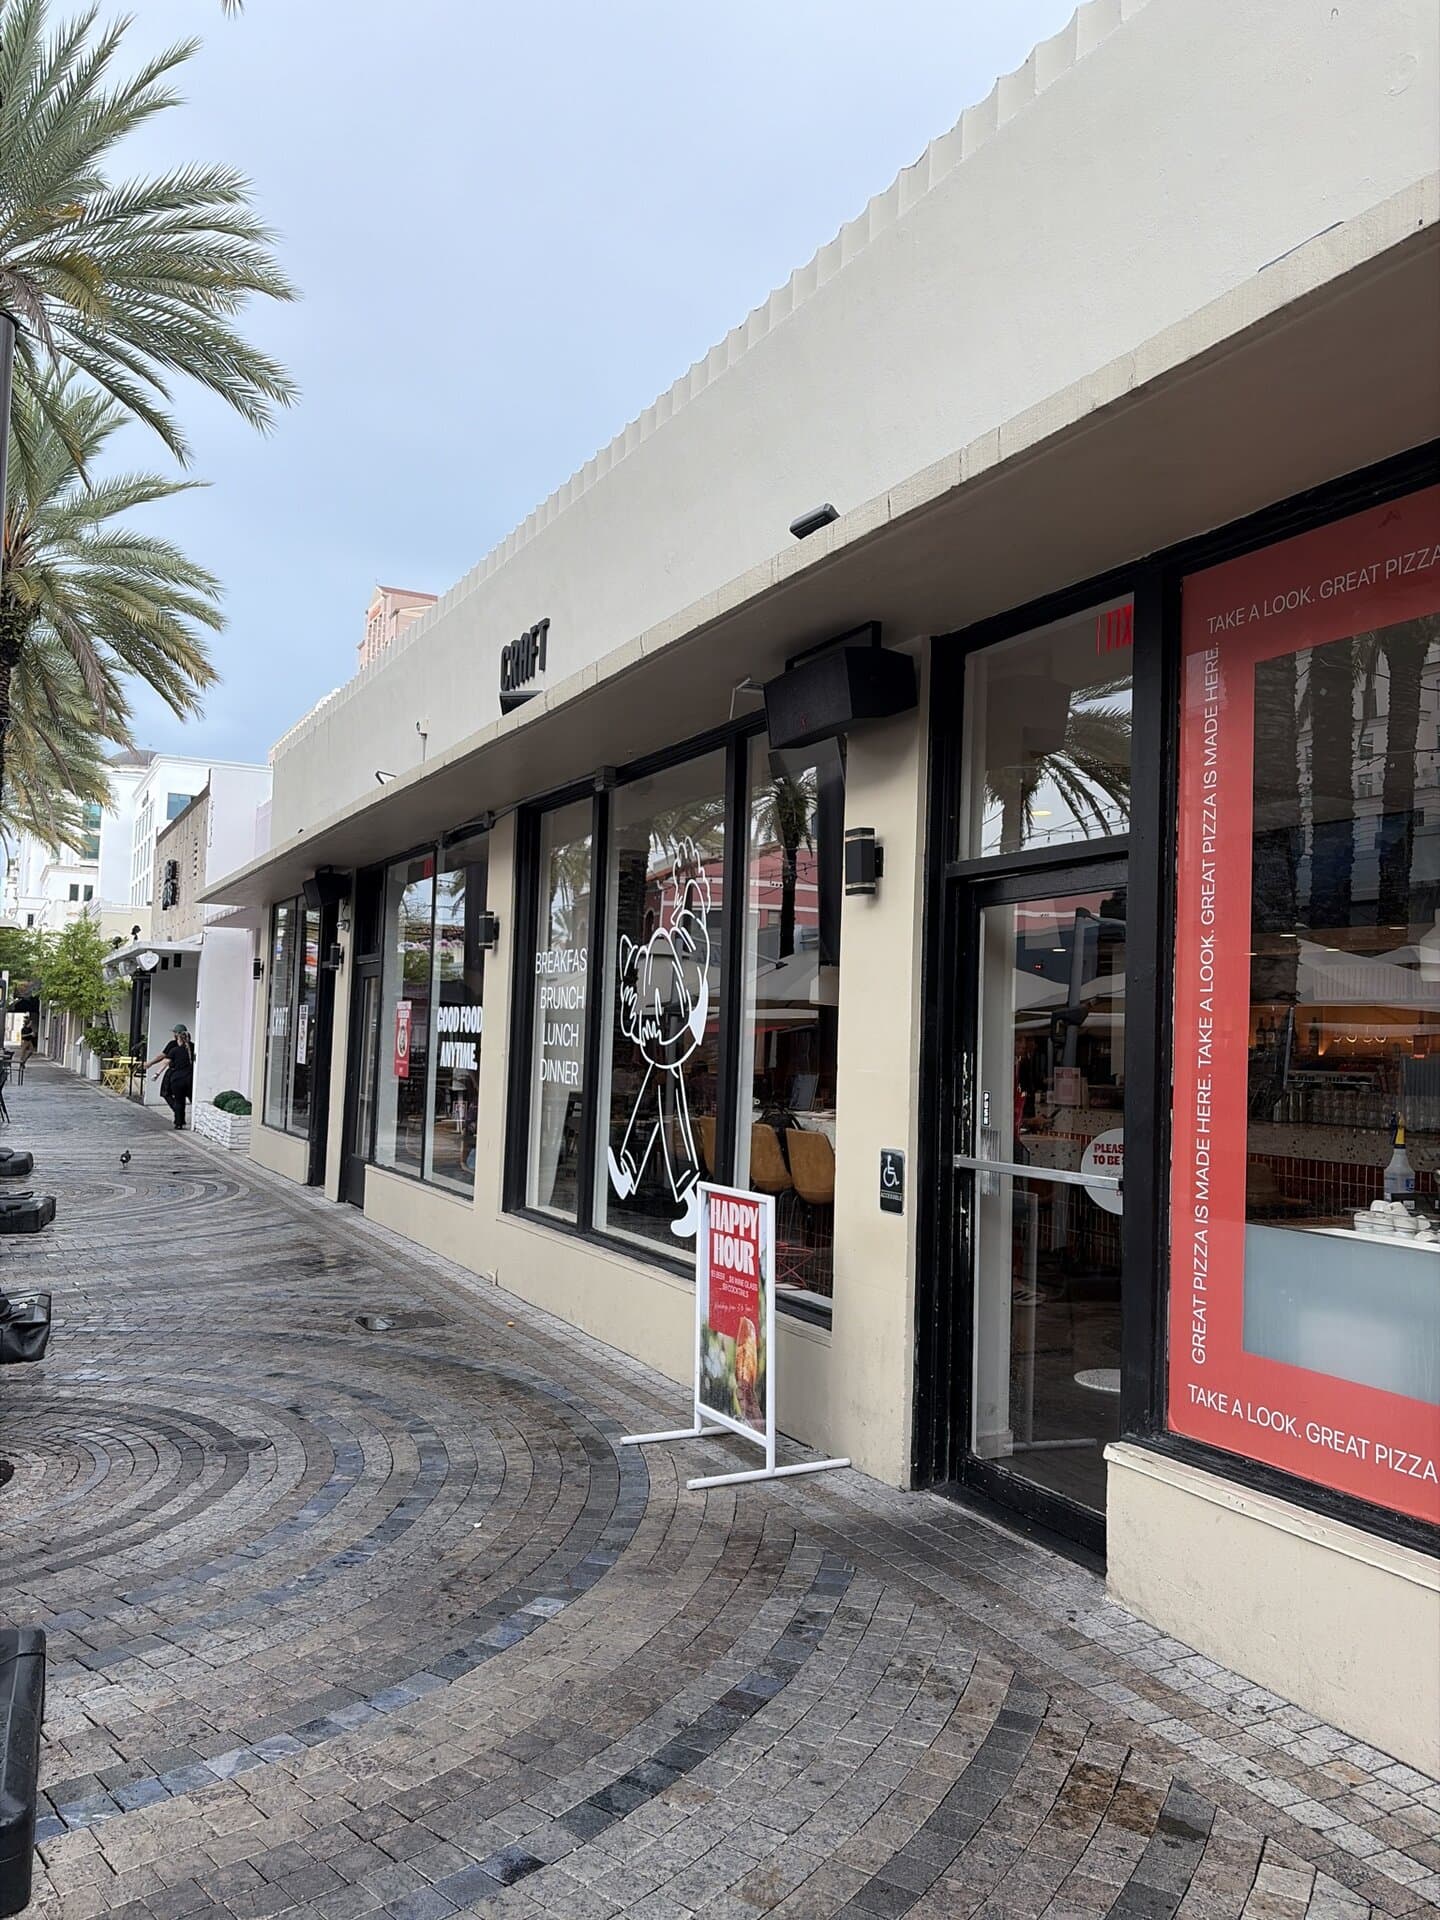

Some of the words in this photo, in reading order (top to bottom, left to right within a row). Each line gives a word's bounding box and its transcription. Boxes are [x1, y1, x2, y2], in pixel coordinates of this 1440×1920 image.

[1207, 607, 1245, 634] TAKE
[1249, 603, 1260, 622] A
[1264, 586, 1316, 617] LOOK.
[1320, 563, 1381, 600] GREAT
[501, 618, 550, 691] CRAFT
[1204, 642, 1219, 702] HERE.
[1204, 705, 1218, 766] MADE
[1203, 770, 1217, 788] IS
[1202, 793, 1217, 853] PIZZA
[1201, 859, 1216, 925] GREAT
[1200, 929, 1215, 992] LOOK.
[437, 1006, 460, 1033] GOOD
[460, 1005, 483, 1033] FOOD
[540, 986, 585, 1009] BRUNCH
[1199, 998, 1214, 1012] A
[542, 1023, 579, 1048] LUNCH
[1198, 1017, 1213, 1069] TAKE
[539, 1058, 579, 1086] DINNER
[1196, 1073, 1212, 1133] HERE.
[1093, 1155, 1105, 1165] TO
[1107, 1156, 1121, 1166] BE
[1195, 1138, 1211, 1200] MADE
[710, 1198, 759, 1240] HAPPY
[1195, 1204, 1210, 1224] IS
[713, 1232, 755, 1276] HOUR
[1193, 1229, 1209, 1291] PIZZA
[1191, 1299, 1207, 1365] GREAT
[1187, 1383, 1228, 1414] TAKE
[1231, 1399, 1244, 1419] A
[1247, 1402, 1302, 1438] LOOK.
[1306, 1422, 1370, 1460] GREAT
[1375, 1443, 1439, 1484] PIZZA
